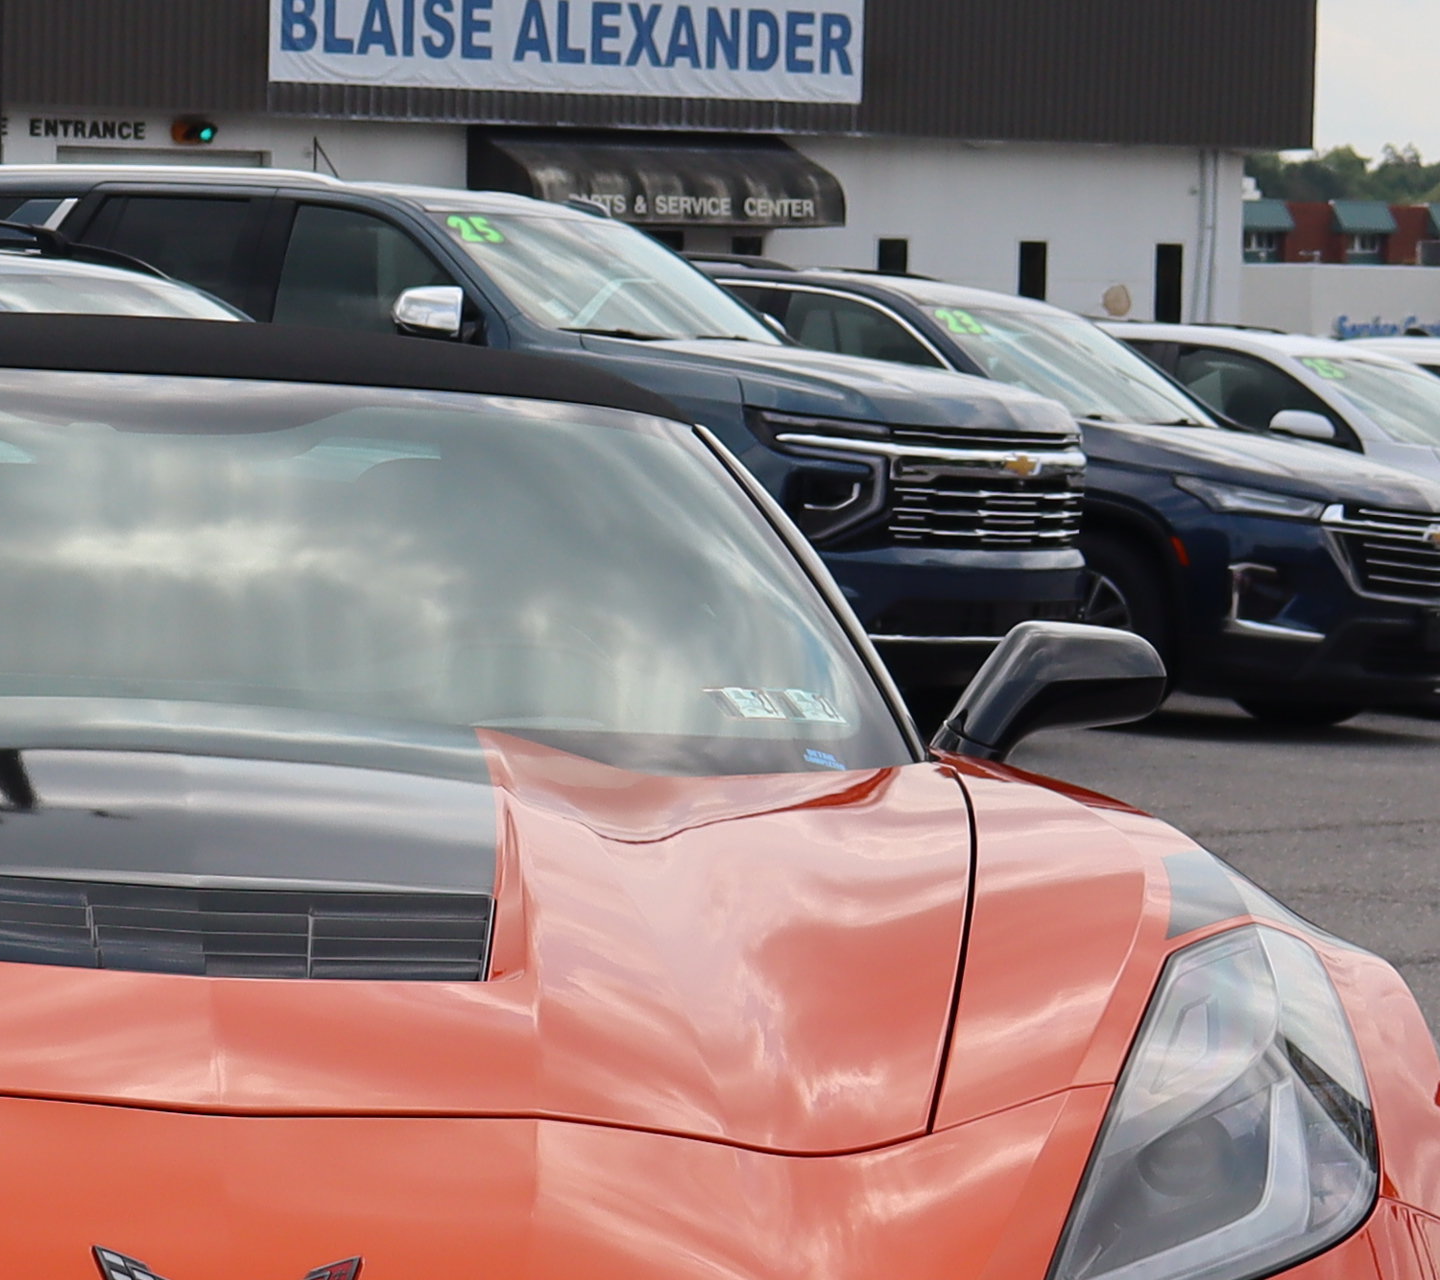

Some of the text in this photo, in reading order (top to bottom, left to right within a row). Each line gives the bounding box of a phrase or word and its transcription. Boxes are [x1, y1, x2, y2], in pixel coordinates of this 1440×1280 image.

[29, 118, 146, 140] ENTRANCE
[634, 195, 647, 214] &
[655, 195, 732, 216] SERVICE
[744, 198, 815, 218] CENTER
[447, 215, 505, 243] 25
[934, 309, 985, 334] 23
